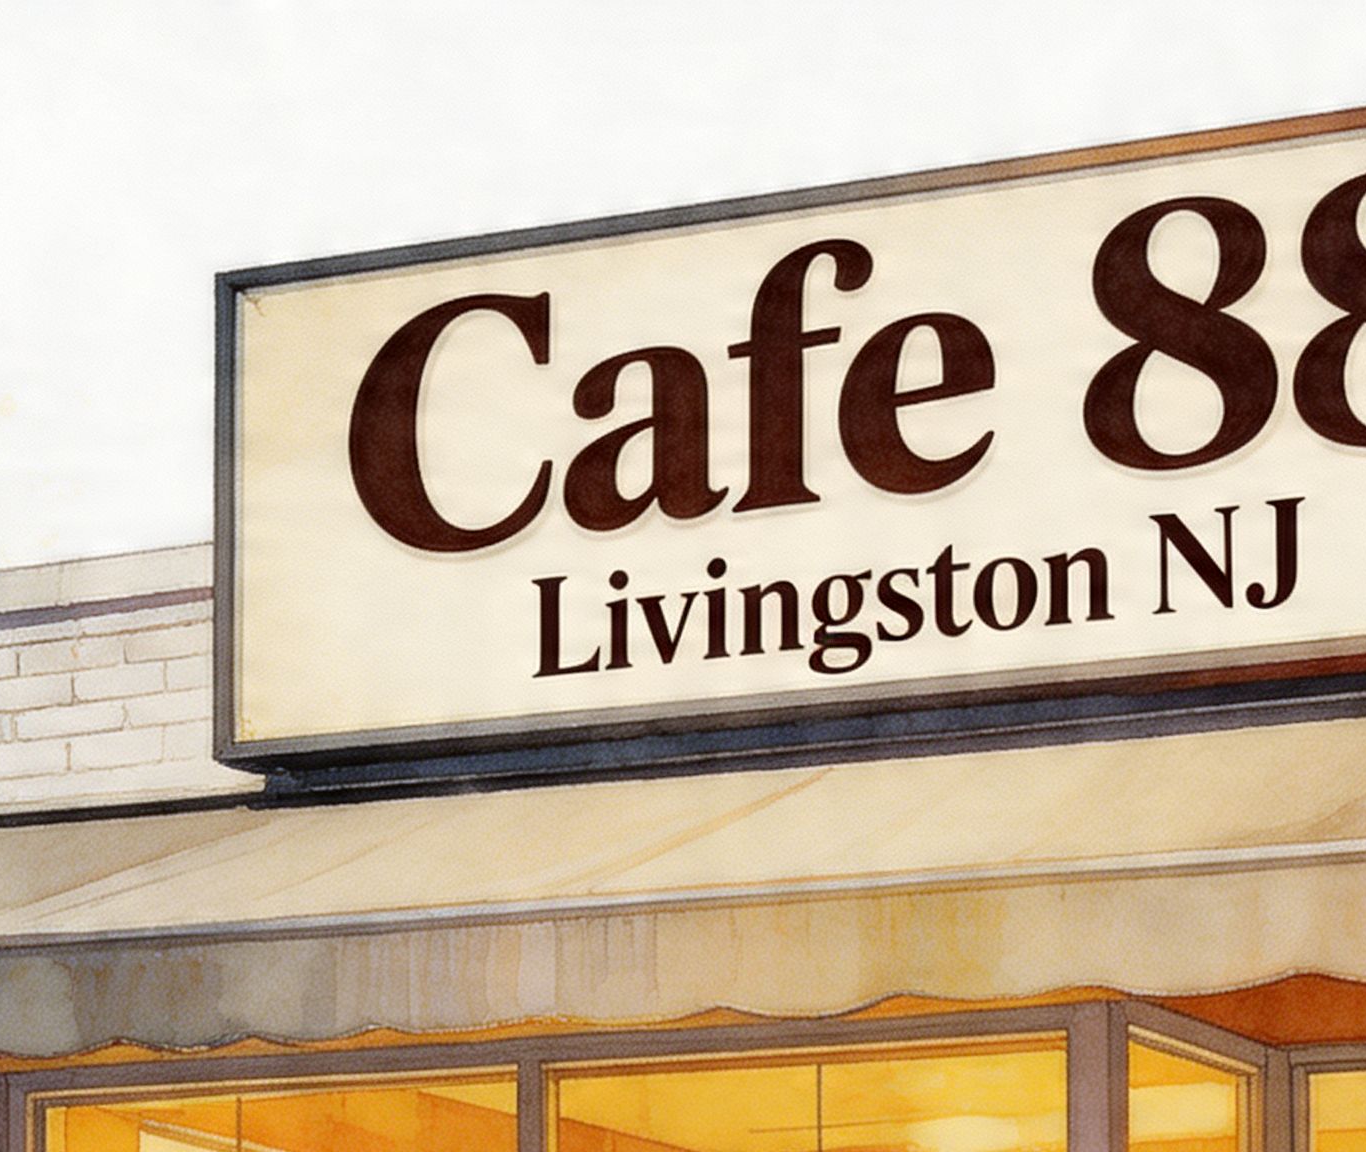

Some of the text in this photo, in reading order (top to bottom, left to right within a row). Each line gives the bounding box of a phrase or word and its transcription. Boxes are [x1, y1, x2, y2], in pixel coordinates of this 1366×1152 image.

[349, 238, 996, 553] Cafe
[531, 496, 1305, 678] Livingston NJ
